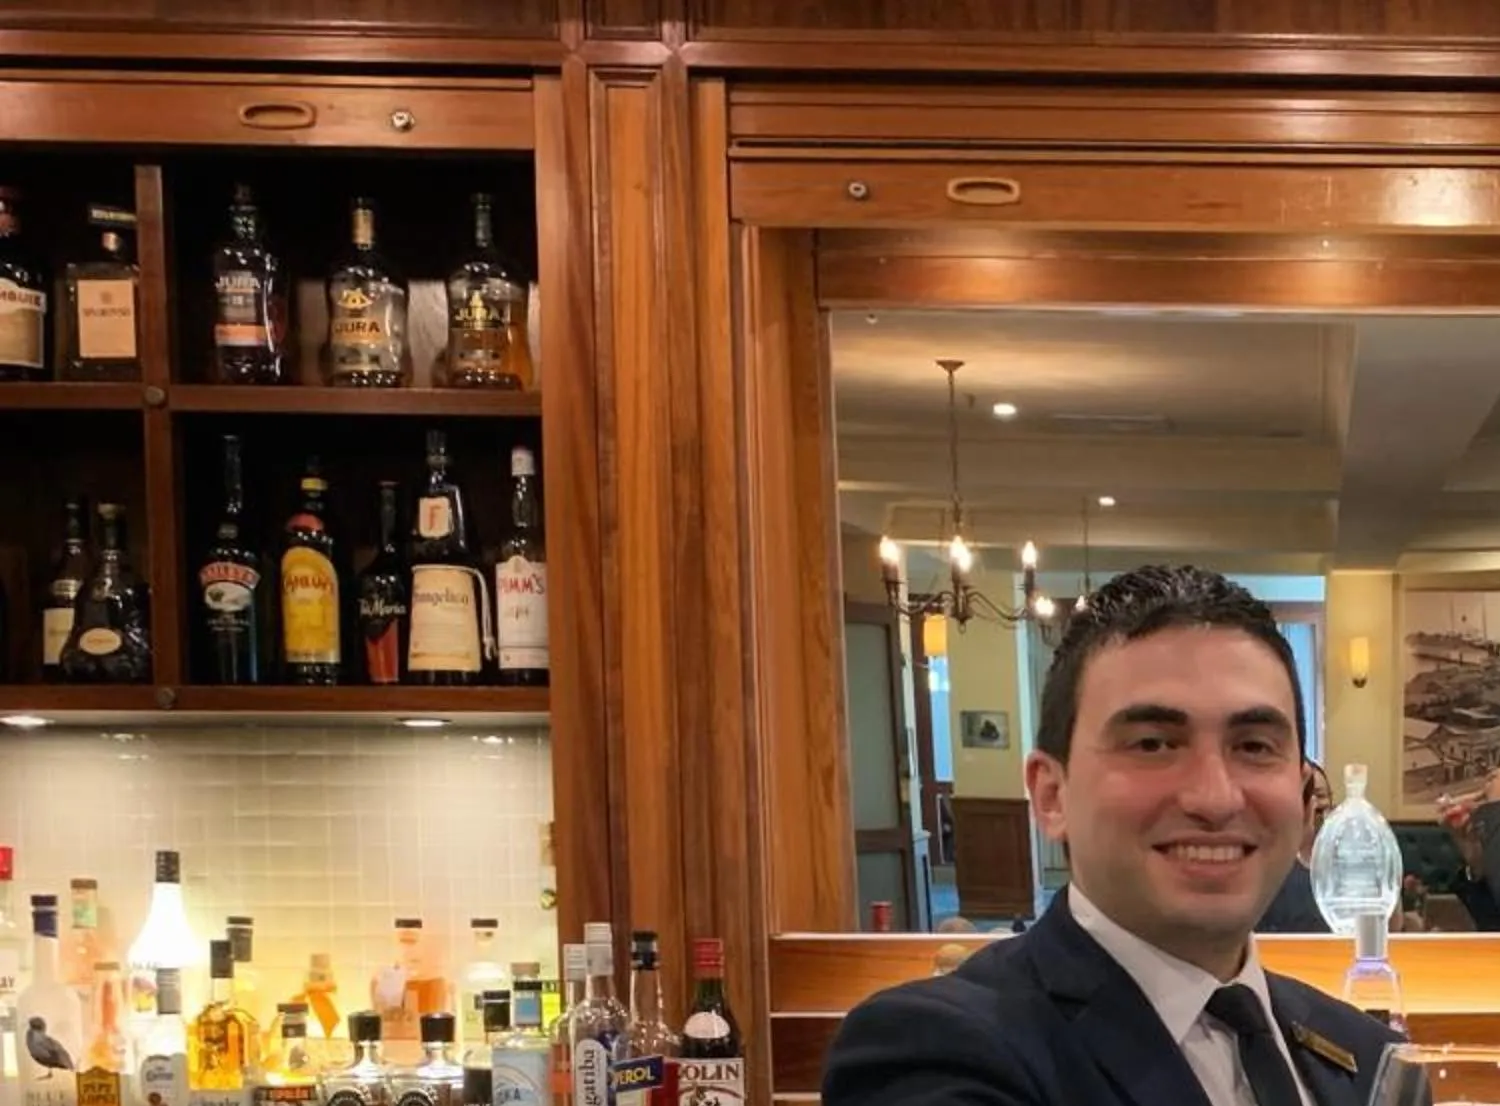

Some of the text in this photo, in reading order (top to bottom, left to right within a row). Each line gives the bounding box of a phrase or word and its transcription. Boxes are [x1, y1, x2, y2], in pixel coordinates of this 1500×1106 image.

[215, 275, 261, 290] JURA
[454, 305, 502, 321] JURA
[335, 320, 381, 335] JURA
